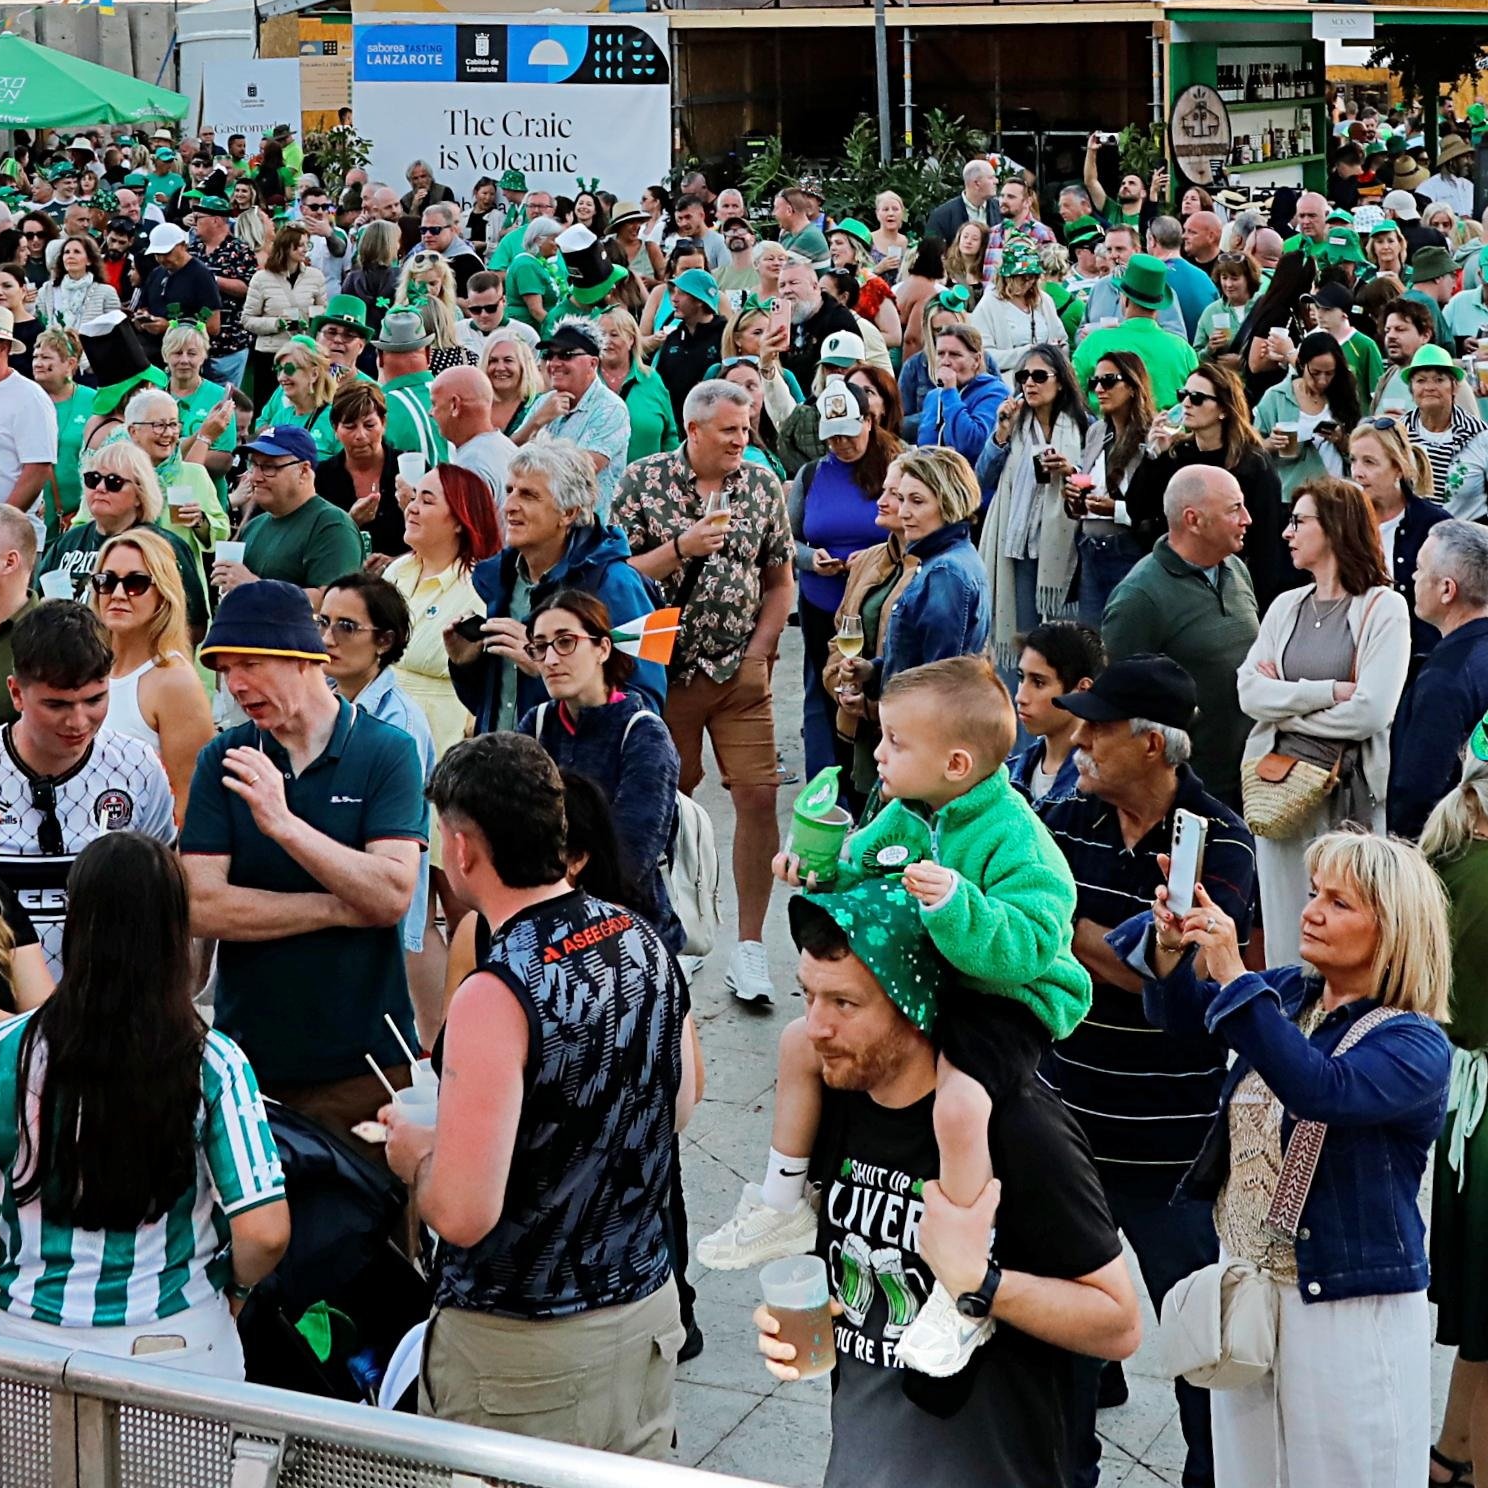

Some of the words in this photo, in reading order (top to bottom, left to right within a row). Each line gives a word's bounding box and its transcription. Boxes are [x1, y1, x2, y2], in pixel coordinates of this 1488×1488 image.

[366, 54, 443, 65] LANZAROTE
[443, 109, 495, 136] The
[502, 110, 572, 138] Craic
[439, 145, 459, 171] is
[465, 144, 578, 173] Volcanic
[851, 1159, 888, 1188] SHUT
[889, 1170, 911, 1195] UP
